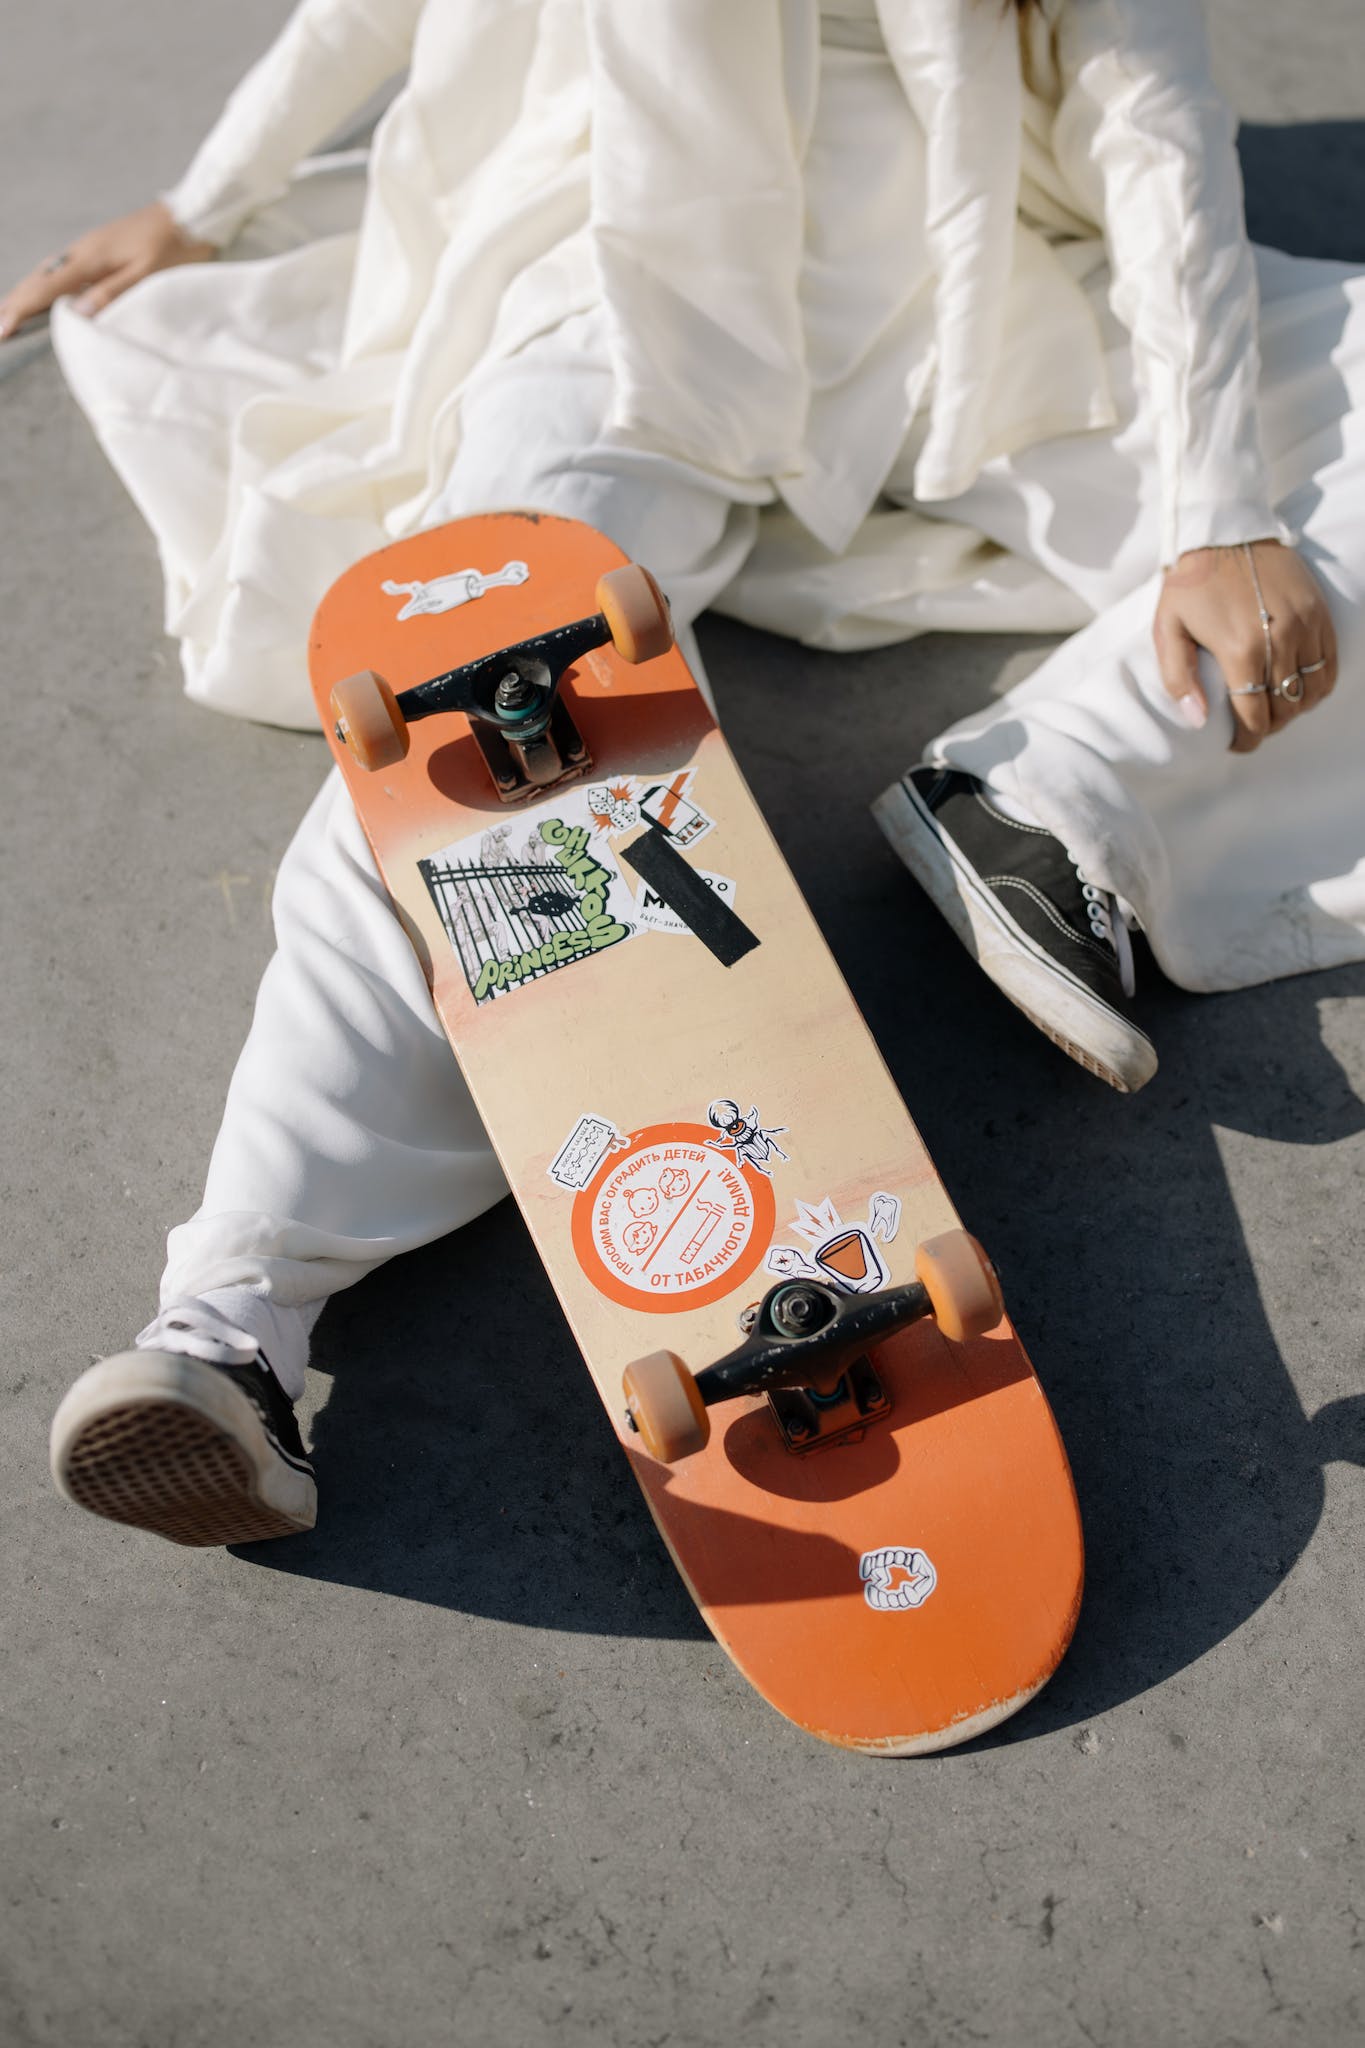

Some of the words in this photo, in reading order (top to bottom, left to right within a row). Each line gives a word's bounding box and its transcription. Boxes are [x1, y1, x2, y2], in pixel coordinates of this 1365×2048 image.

[606, 1153, 660, 1198] ОГРАДИТЬ
[664, 1149, 707, 1163] ДЕТЕЙ
[599, 1201, 612, 1225] ВАС
[650, 1273, 671, 1287] ОТ
[674, 1222, 746, 1286] ТАБАЧНОГО
[717, 1168, 750, 1217] ДЫМА!
[600, 1228, 634, 1275] ПРОСИМ
